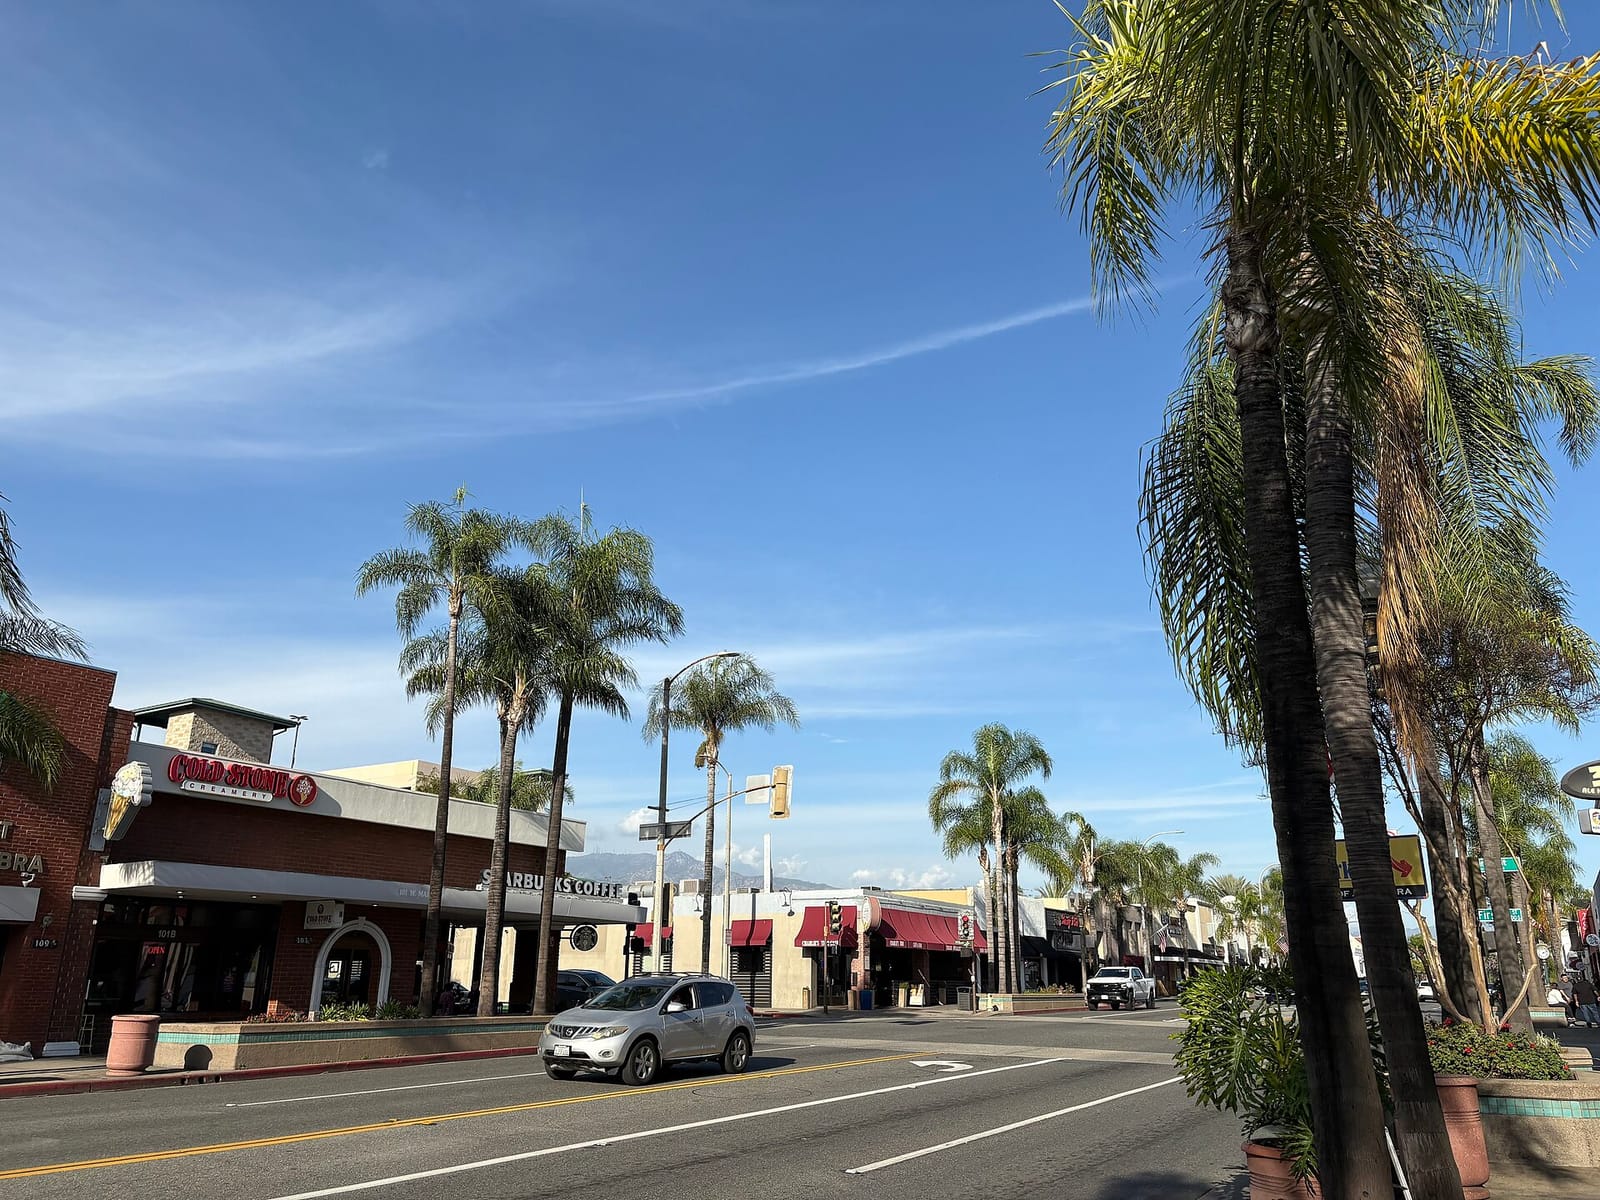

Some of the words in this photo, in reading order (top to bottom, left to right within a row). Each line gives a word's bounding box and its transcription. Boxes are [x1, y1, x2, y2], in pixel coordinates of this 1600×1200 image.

[168, 754, 225, 783] COLD
[225, 762, 290, 798] STONE
[189, 782, 267, 800] CREAMERY
[481, 868, 572, 893] SARBUKS
[575, 880, 622, 898] COFFEE
[158, 929, 177, 938] 101B
